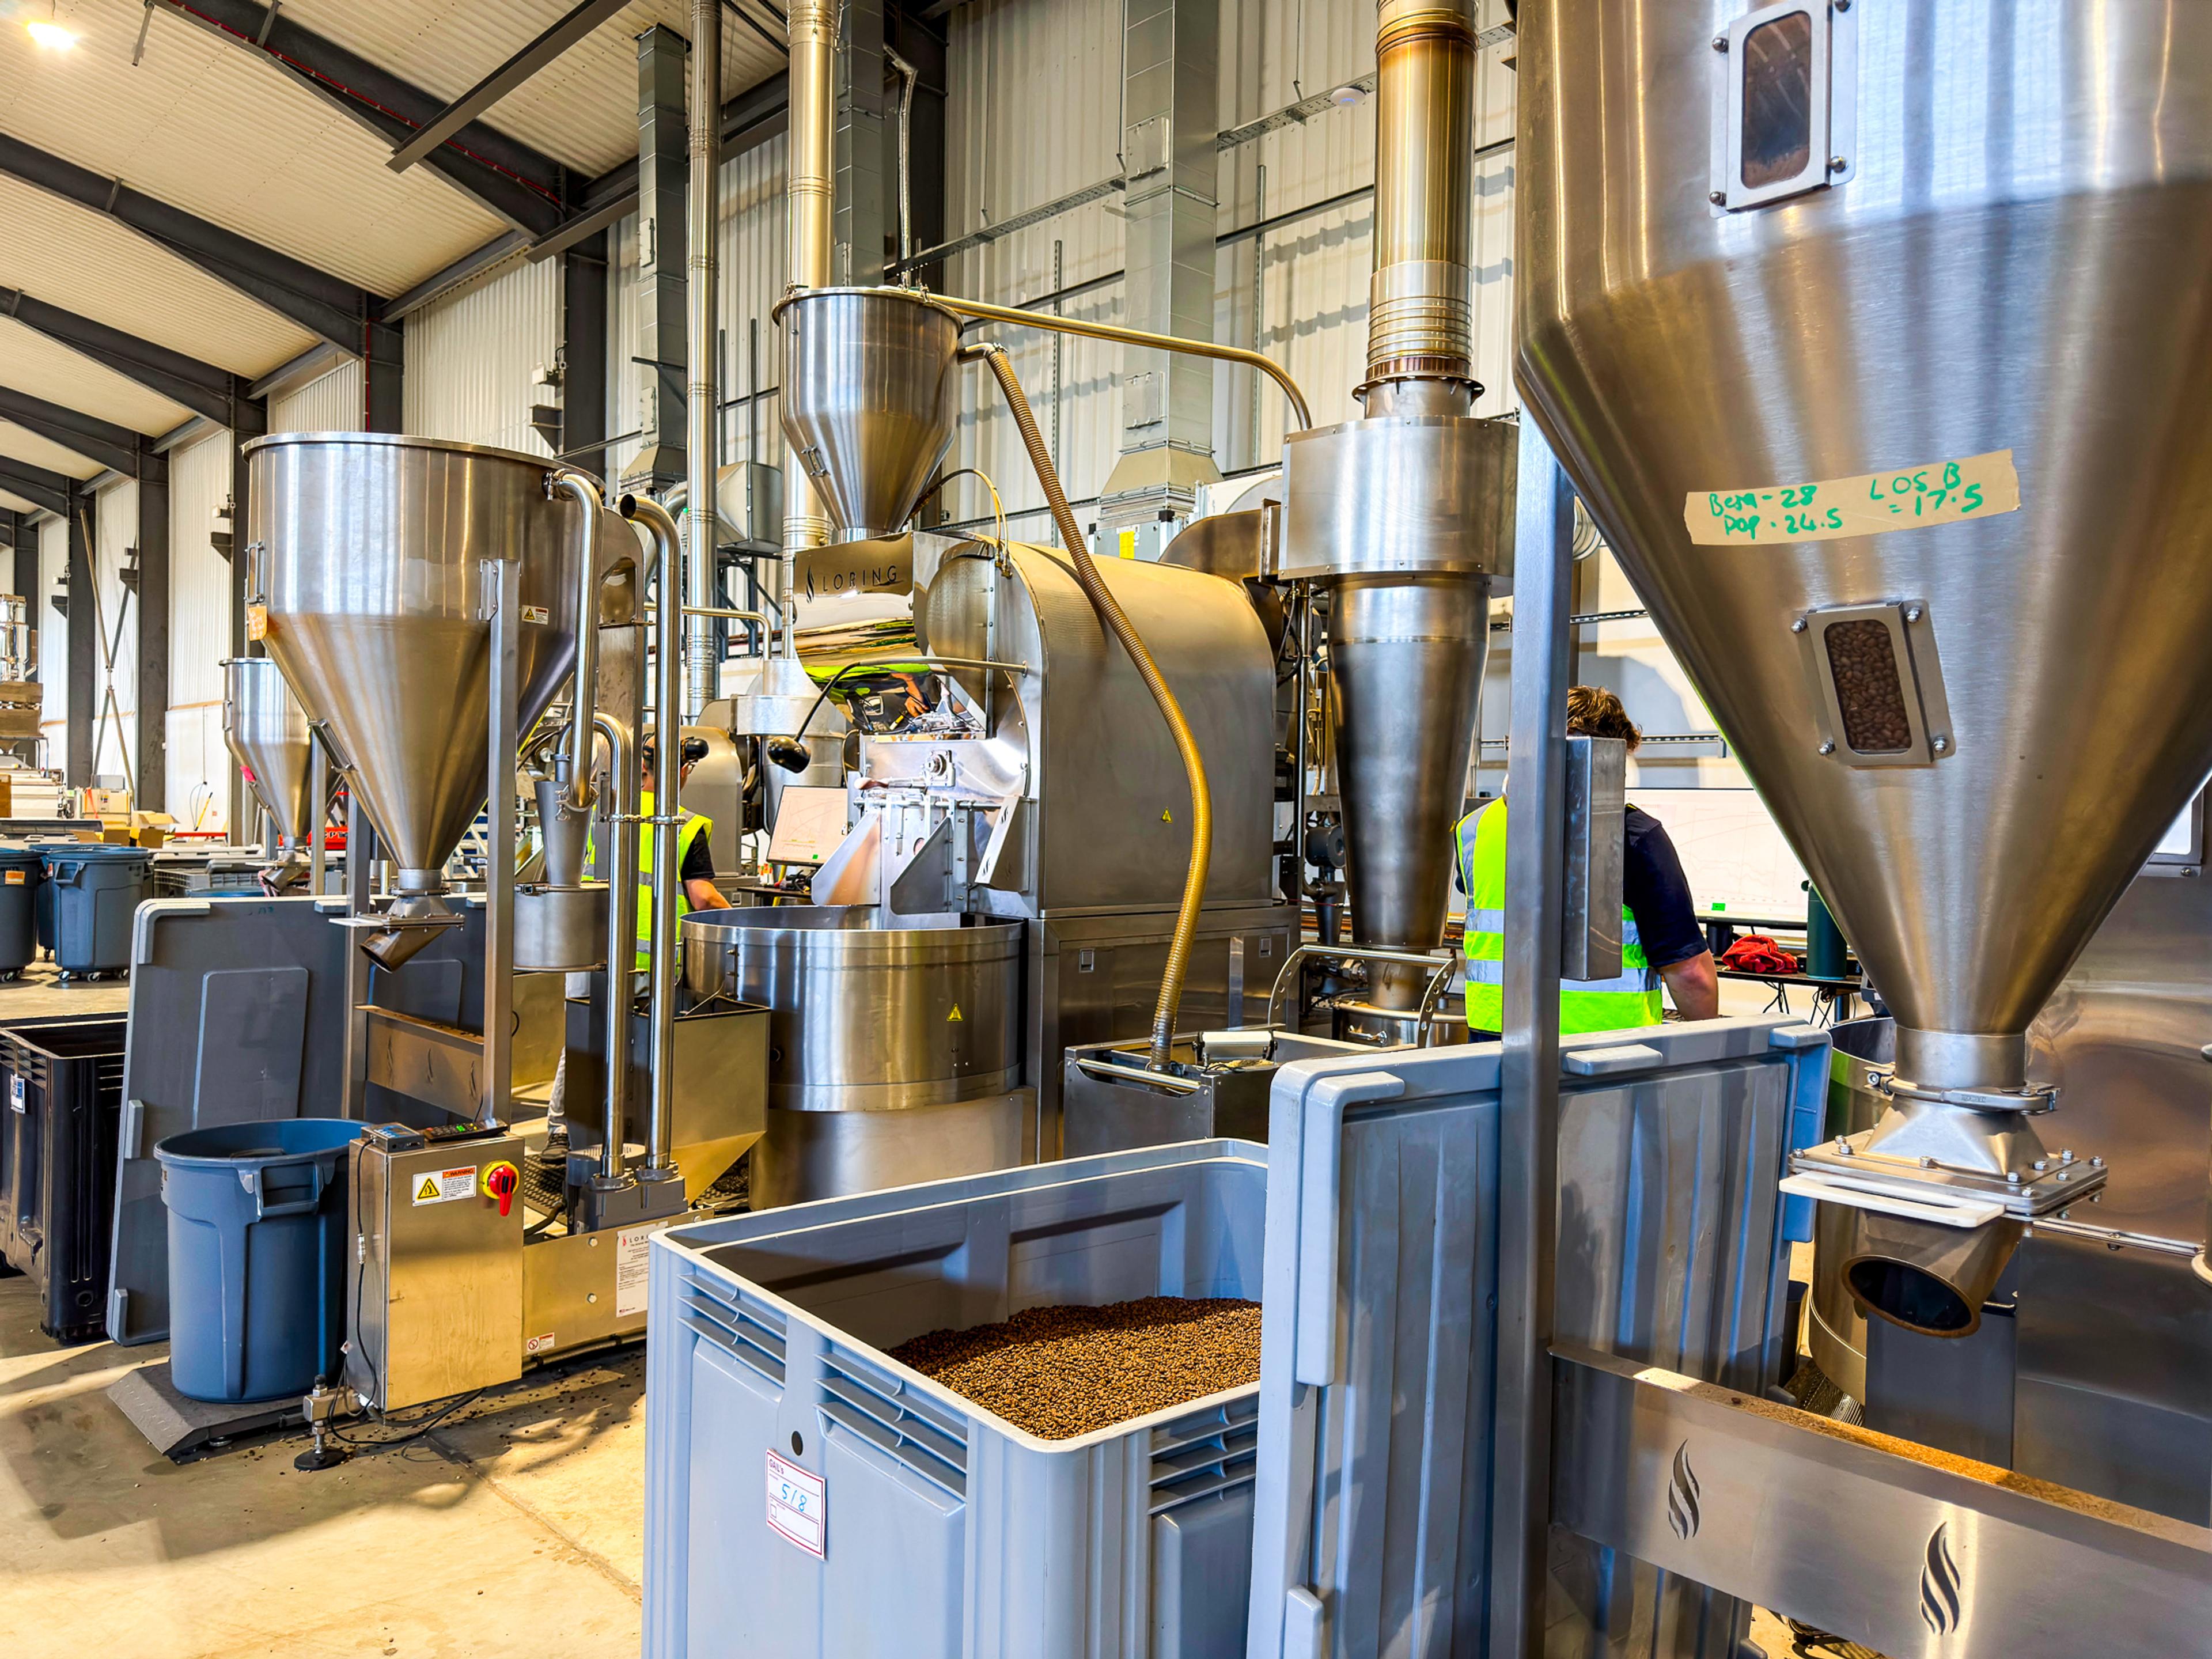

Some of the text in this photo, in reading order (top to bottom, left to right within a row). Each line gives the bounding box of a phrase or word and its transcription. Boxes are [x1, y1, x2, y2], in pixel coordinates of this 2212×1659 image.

[1943, 461, 1961, 490] B
[822, 565, 897, 592] LORING
[629, 1235, 649, 1243] LORI
[769, 1459, 784, 1474] GAIL's
